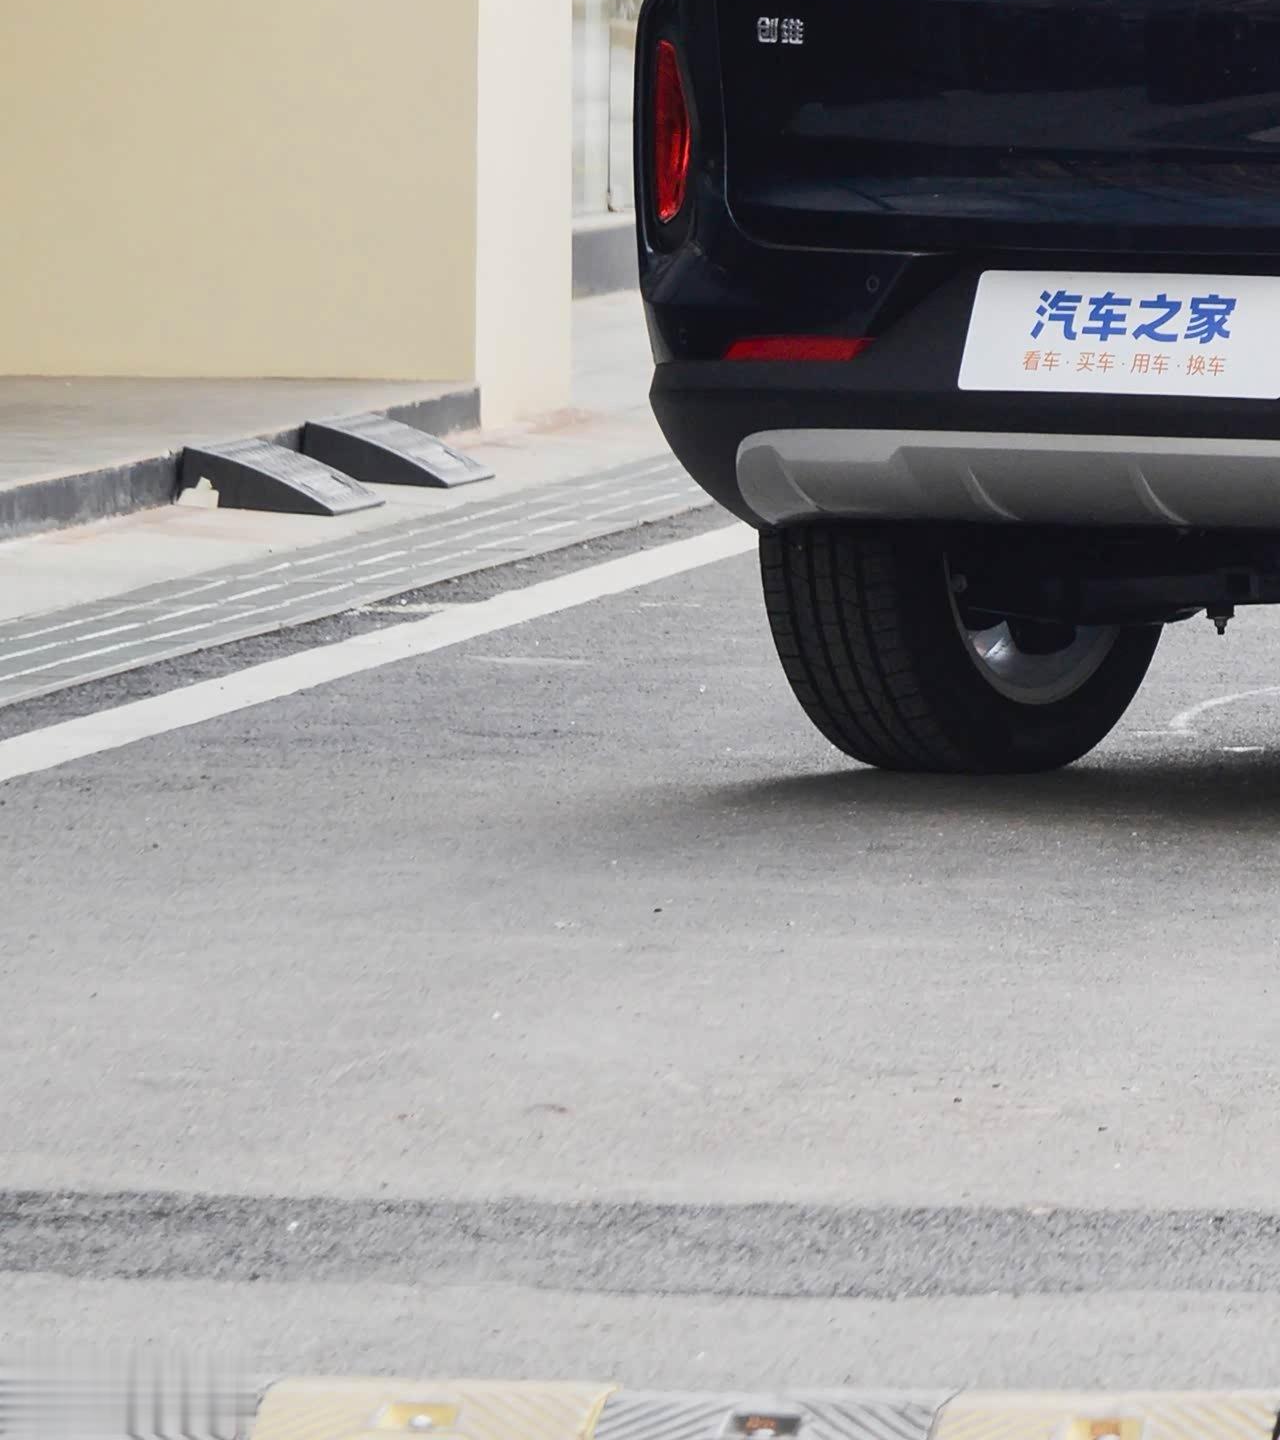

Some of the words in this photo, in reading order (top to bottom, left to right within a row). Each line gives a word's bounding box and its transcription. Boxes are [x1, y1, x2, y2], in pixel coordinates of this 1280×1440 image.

[757, 17, 804, 44] 创维
[1030, 290, 1237, 344] 汽车之家
